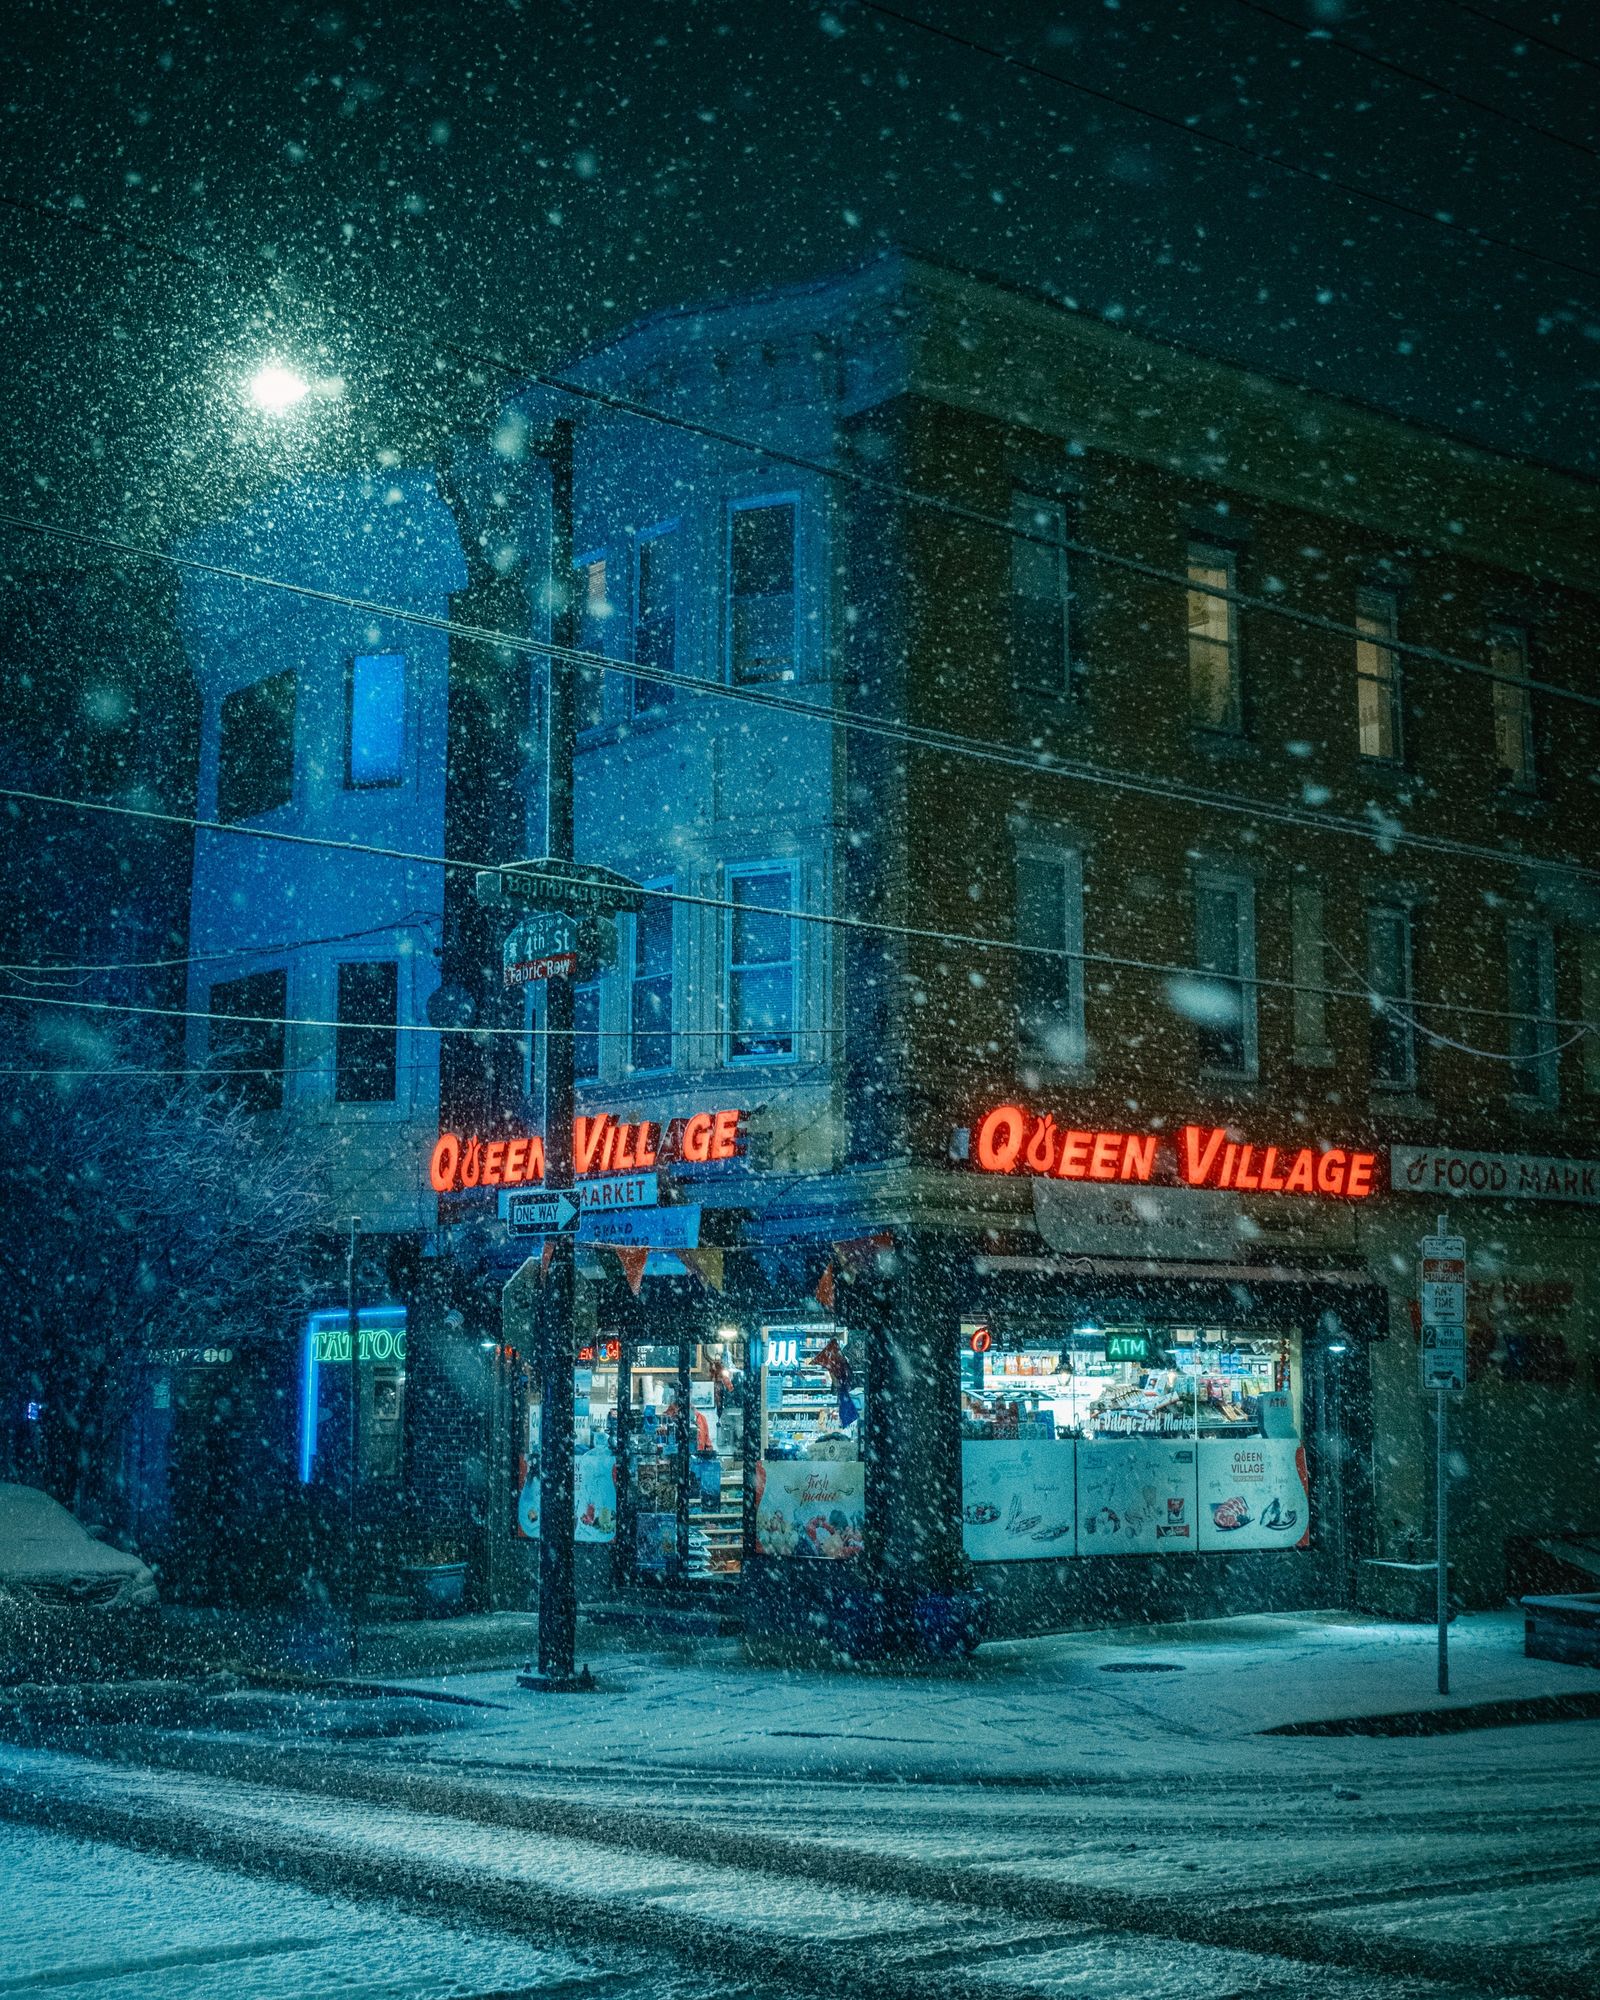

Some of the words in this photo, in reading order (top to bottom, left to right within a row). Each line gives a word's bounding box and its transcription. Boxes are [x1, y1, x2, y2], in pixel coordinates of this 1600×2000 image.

[523, 933, 546, 960] 4th
[553, 927, 570, 953] St
[509, 961, 543, 984] Fabric
[546, 957, 571, 977] Row
[573, 1110, 740, 1173] VILLAGE
[977, 1105, 1157, 1181] QUEEN
[1183, 1125, 1376, 1197] VILLAGE
[1434, 1158, 1507, 1191] FOOD
[516, 1206, 535, 1223] ONE
[538, 1204, 559, 1222] WAY
[1424, 1271, 1464, 1282] STOPPING
[1435, 1286, 1454, 1296] ANY
[1434, 1297, 1454, 1308] TIME
[1425, 1328, 1434, 1346] 2
[1110, 1338, 1145, 1355] ATM
[1269, 1398, 1288, 1408] ATM
[1234, 1451, 1263, 1461] QUEEN
[1231, 1463, 1265, 1474] VILLAGE
[805, 1473, 829, 1490] Fresh
